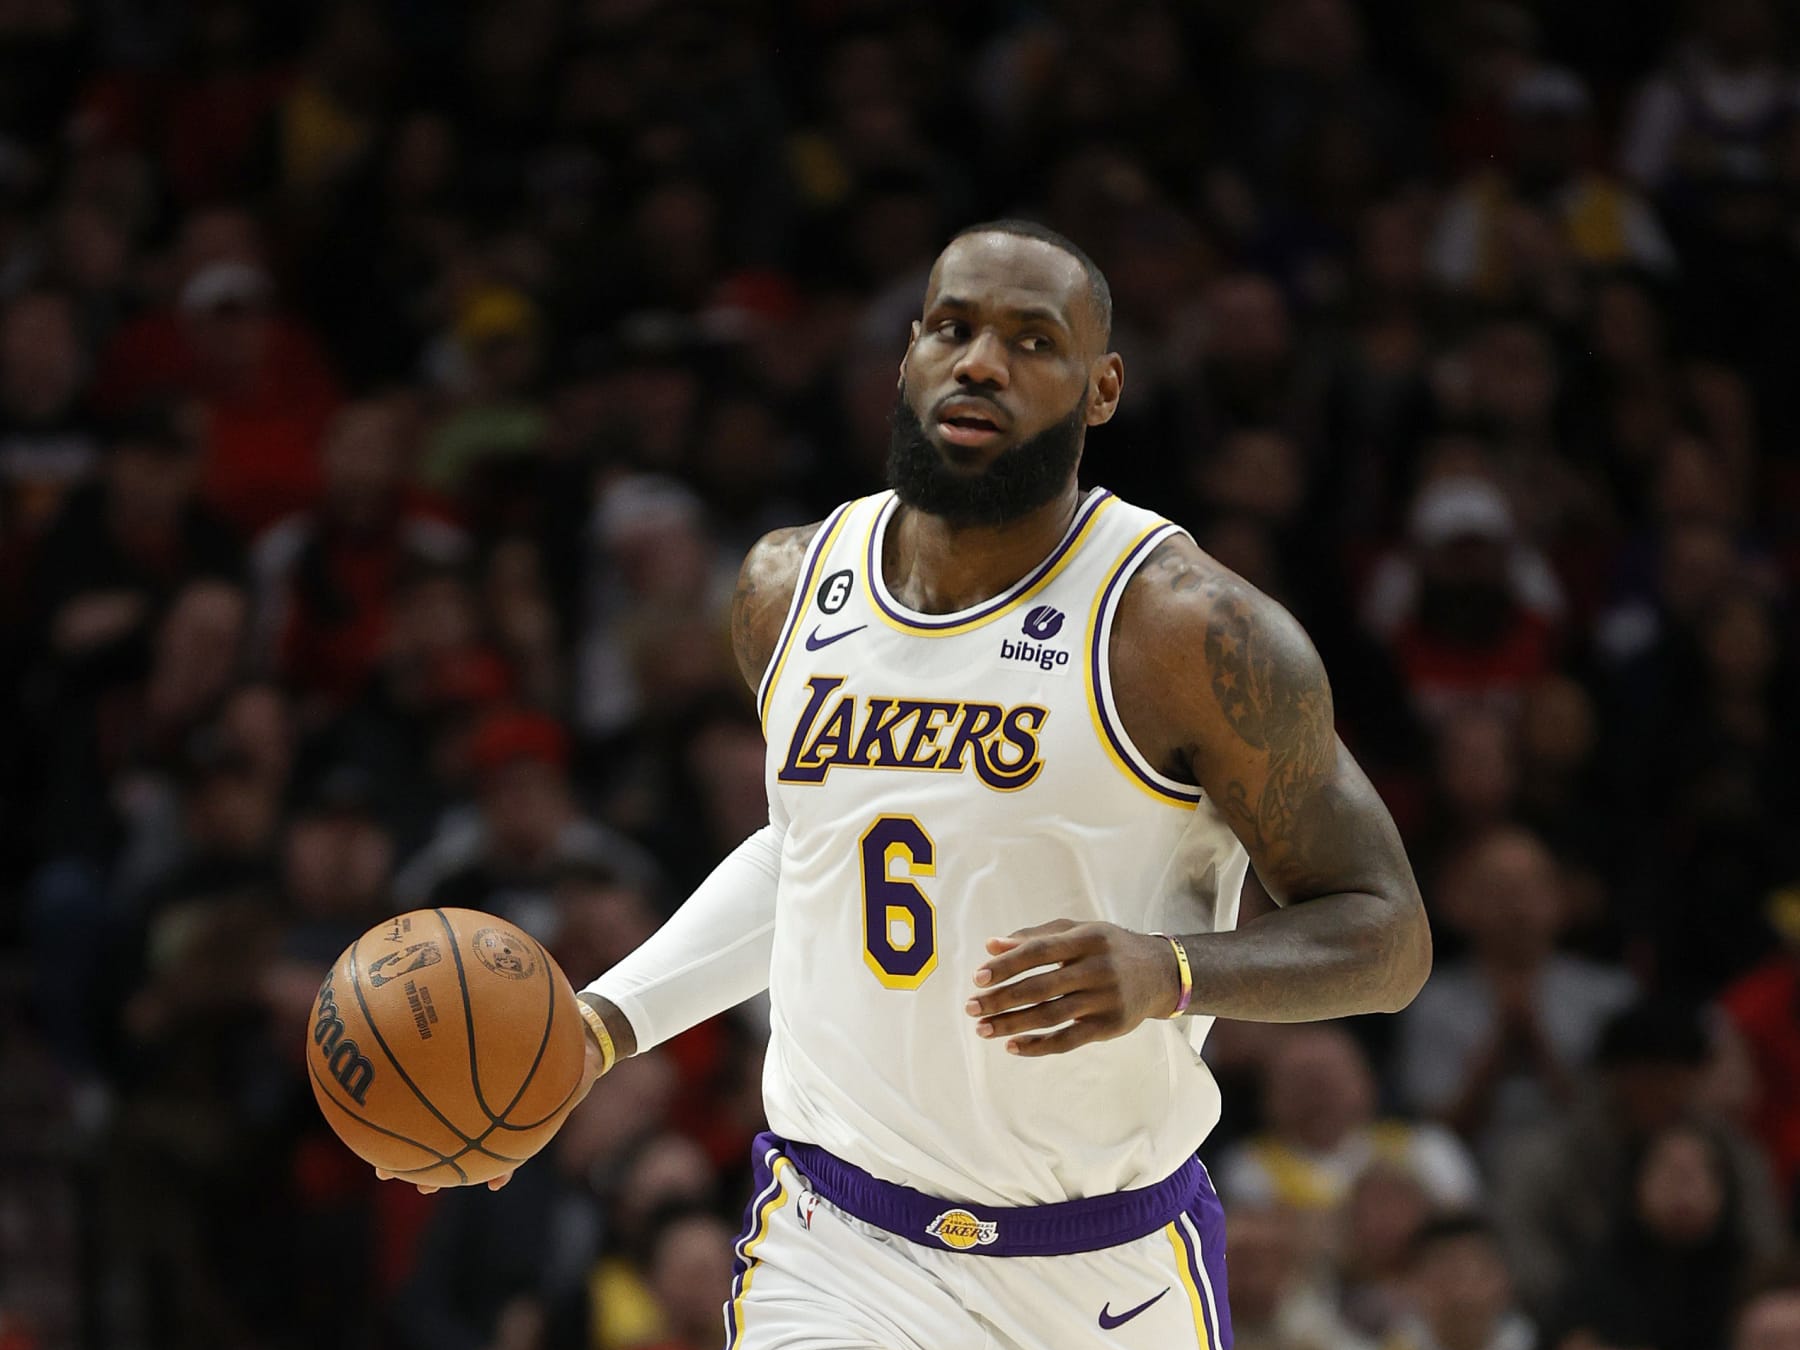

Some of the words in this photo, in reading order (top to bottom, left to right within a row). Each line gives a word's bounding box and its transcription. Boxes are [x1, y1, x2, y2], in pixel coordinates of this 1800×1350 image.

[823, 574, 851, 610] 6
[1000, 638, 1070, 671] bibigo
[777, 674, 1051, 793] LAKERS
[858, 812, 939, 991] 6
[930, 1218, 996, 1243] LAKERS
